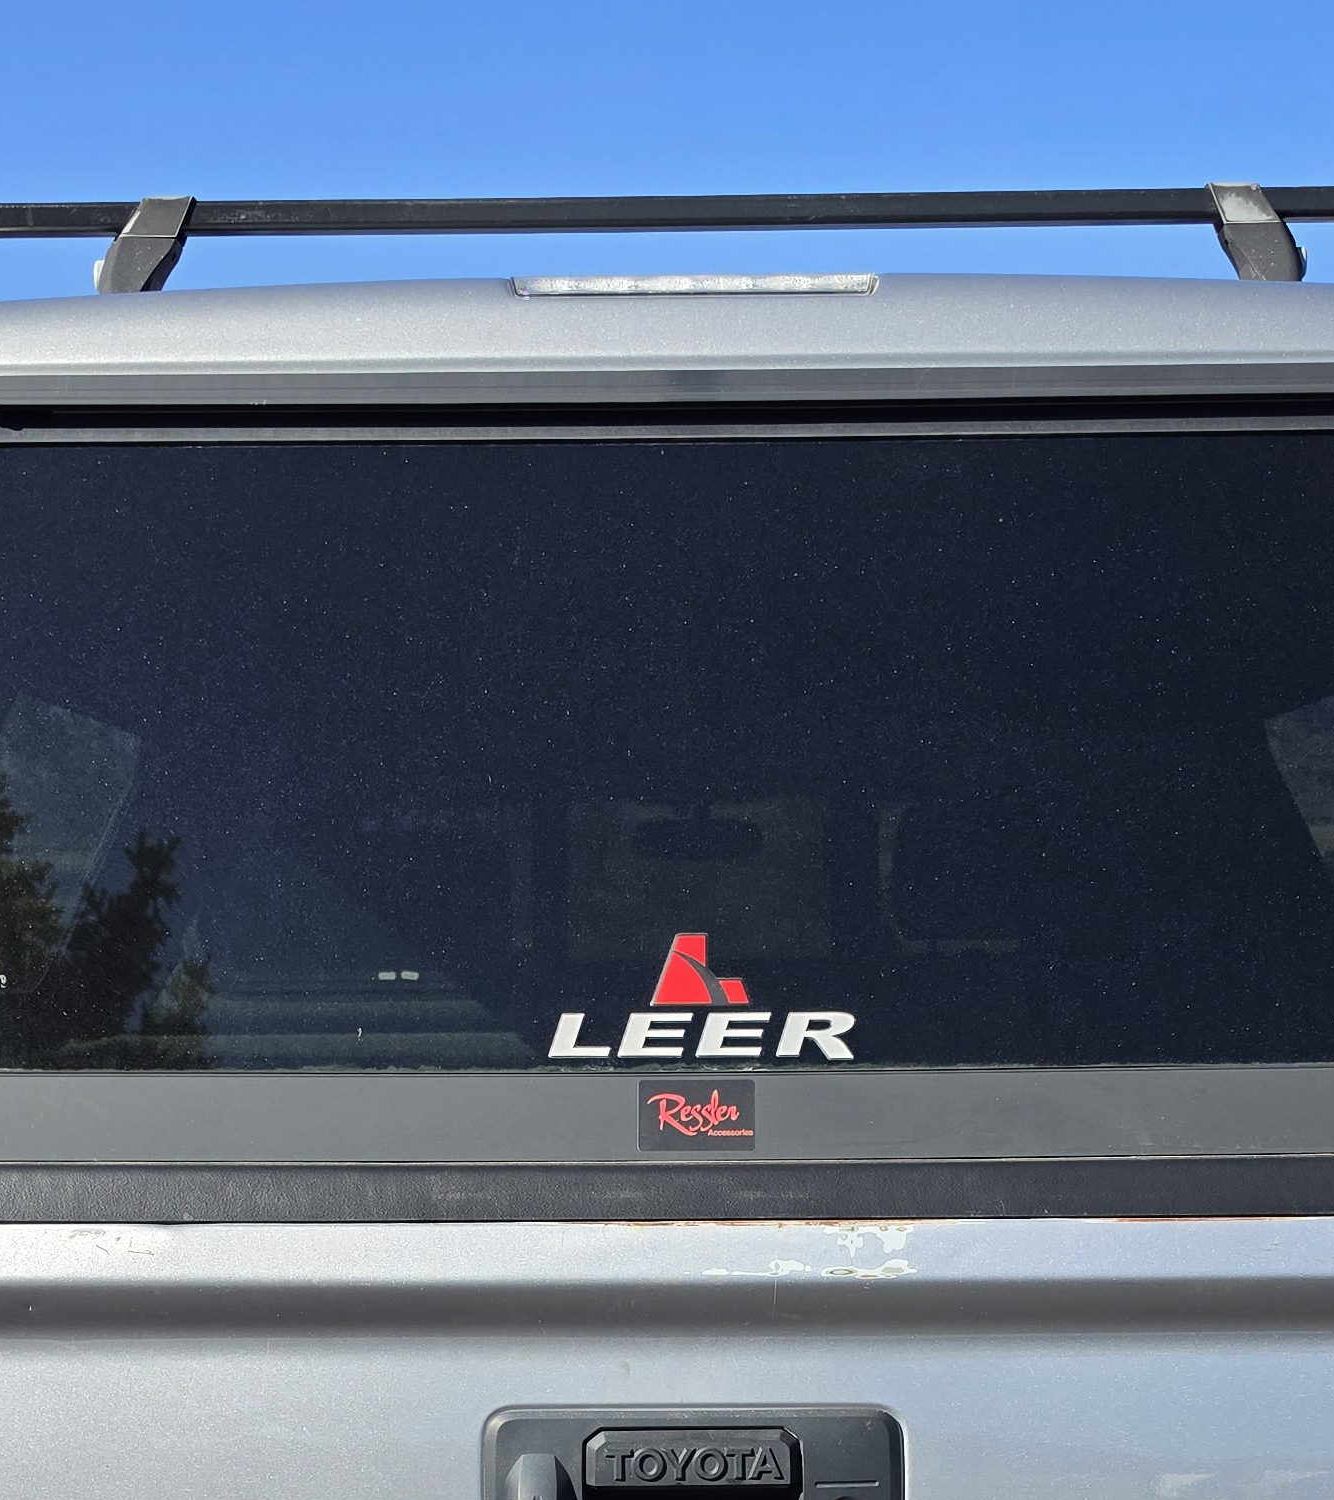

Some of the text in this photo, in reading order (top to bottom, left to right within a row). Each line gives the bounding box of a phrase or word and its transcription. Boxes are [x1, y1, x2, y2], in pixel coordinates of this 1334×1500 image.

[547, 1011, 857, 1061] LEER
[647, 1089, 740, 1136] Ressler
[707, 1128, 754, 1137] Accessories
[604, 1446, 785, 1483] TOYOTA
